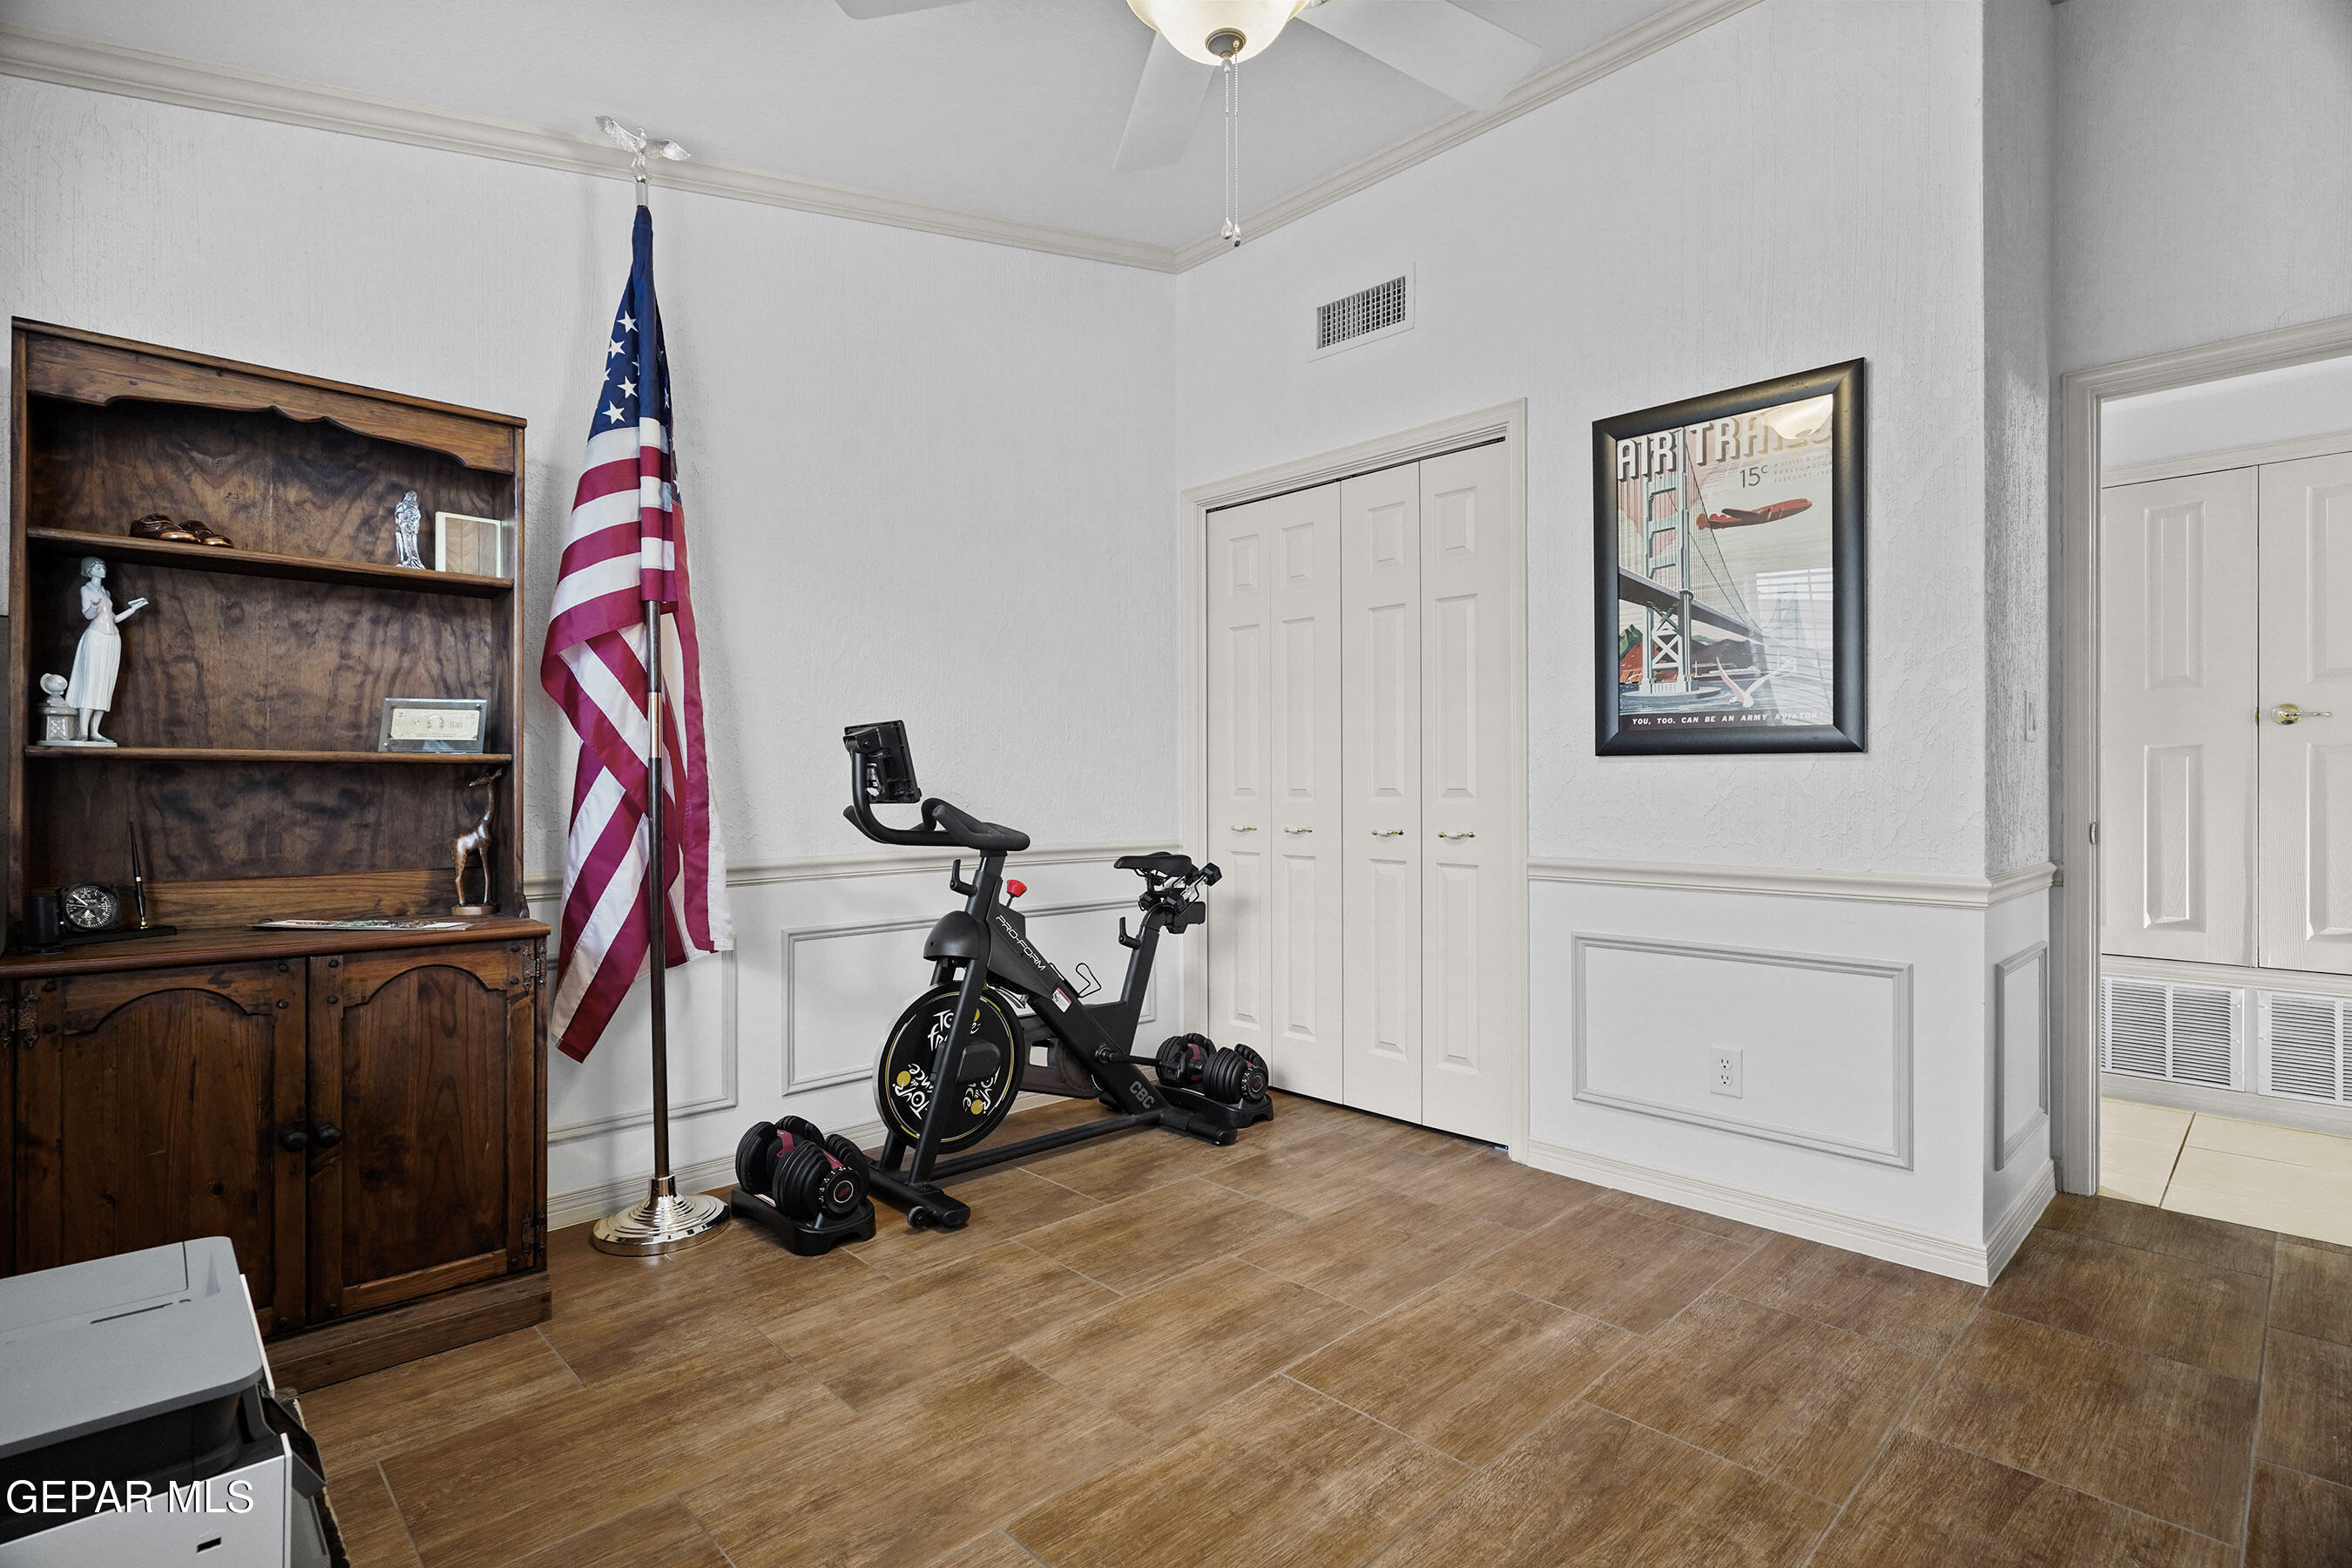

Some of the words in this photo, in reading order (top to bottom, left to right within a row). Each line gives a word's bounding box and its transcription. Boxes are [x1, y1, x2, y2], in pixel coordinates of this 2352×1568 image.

[1618, 430, 1680, 482] AIR
[1690, 399, 1832, 466] TRA
[1740, 713, 1767, 722] ARMY
[996, 915, 1046, 971] PRO-FORM
[1130, 1081, 1155, 1109] CBC
